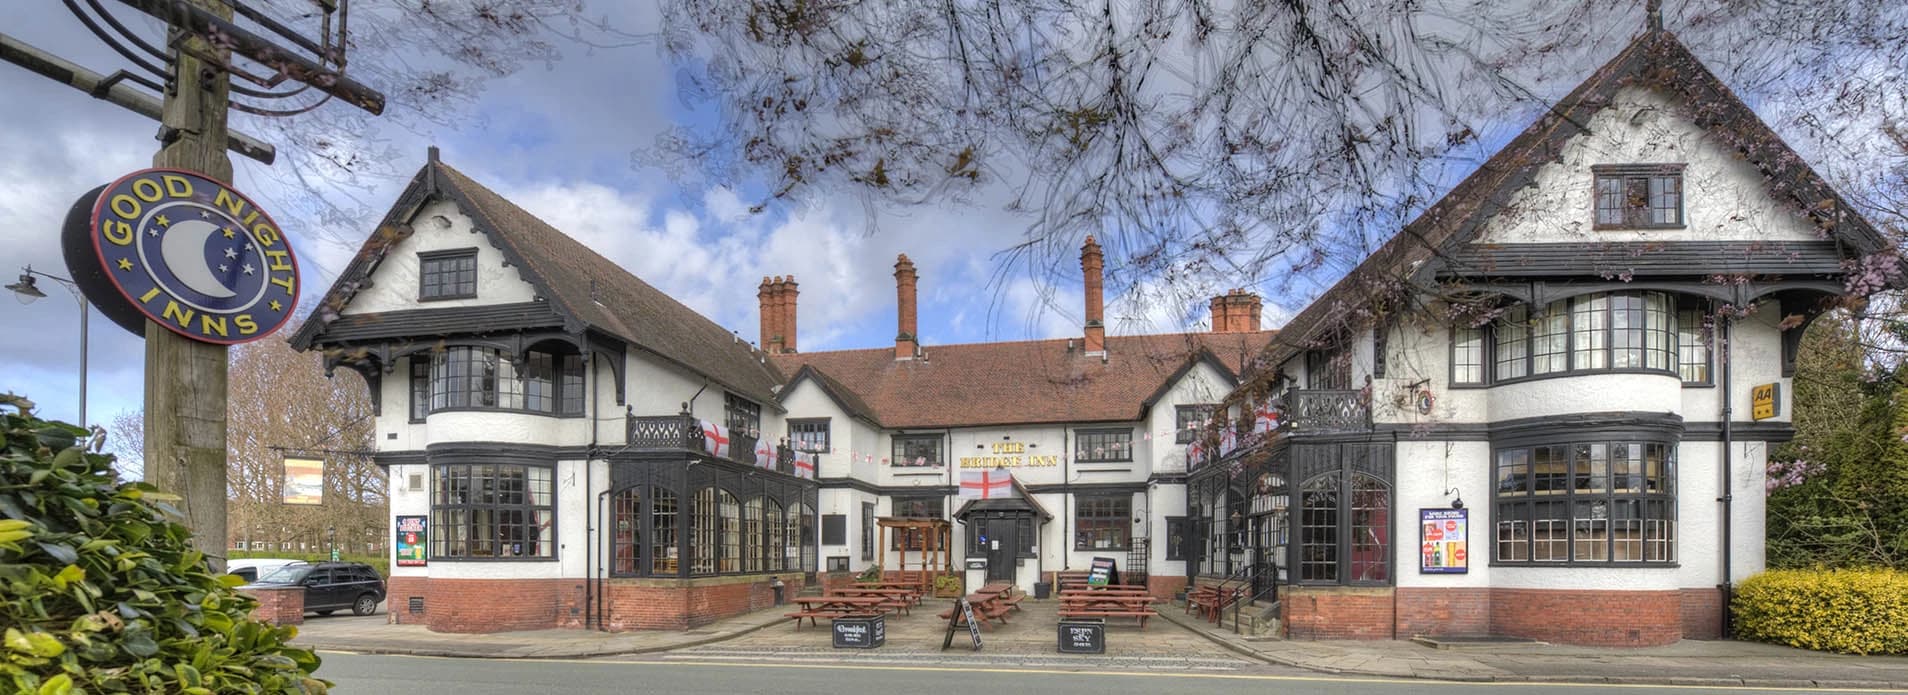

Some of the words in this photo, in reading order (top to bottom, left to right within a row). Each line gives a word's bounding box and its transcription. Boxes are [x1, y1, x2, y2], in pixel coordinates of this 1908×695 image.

[102, 175, 193, 246] GOOD
[214, 187, 295, 296] NIGHT
[138, 286, 259, 337] INNS
[1755, 388, 1771, 401] AA
[992, 441, 1024, 454] THE
[960, 456, 1022, 468] BRIDGE
[1029, 455, 1057, 467] INN
